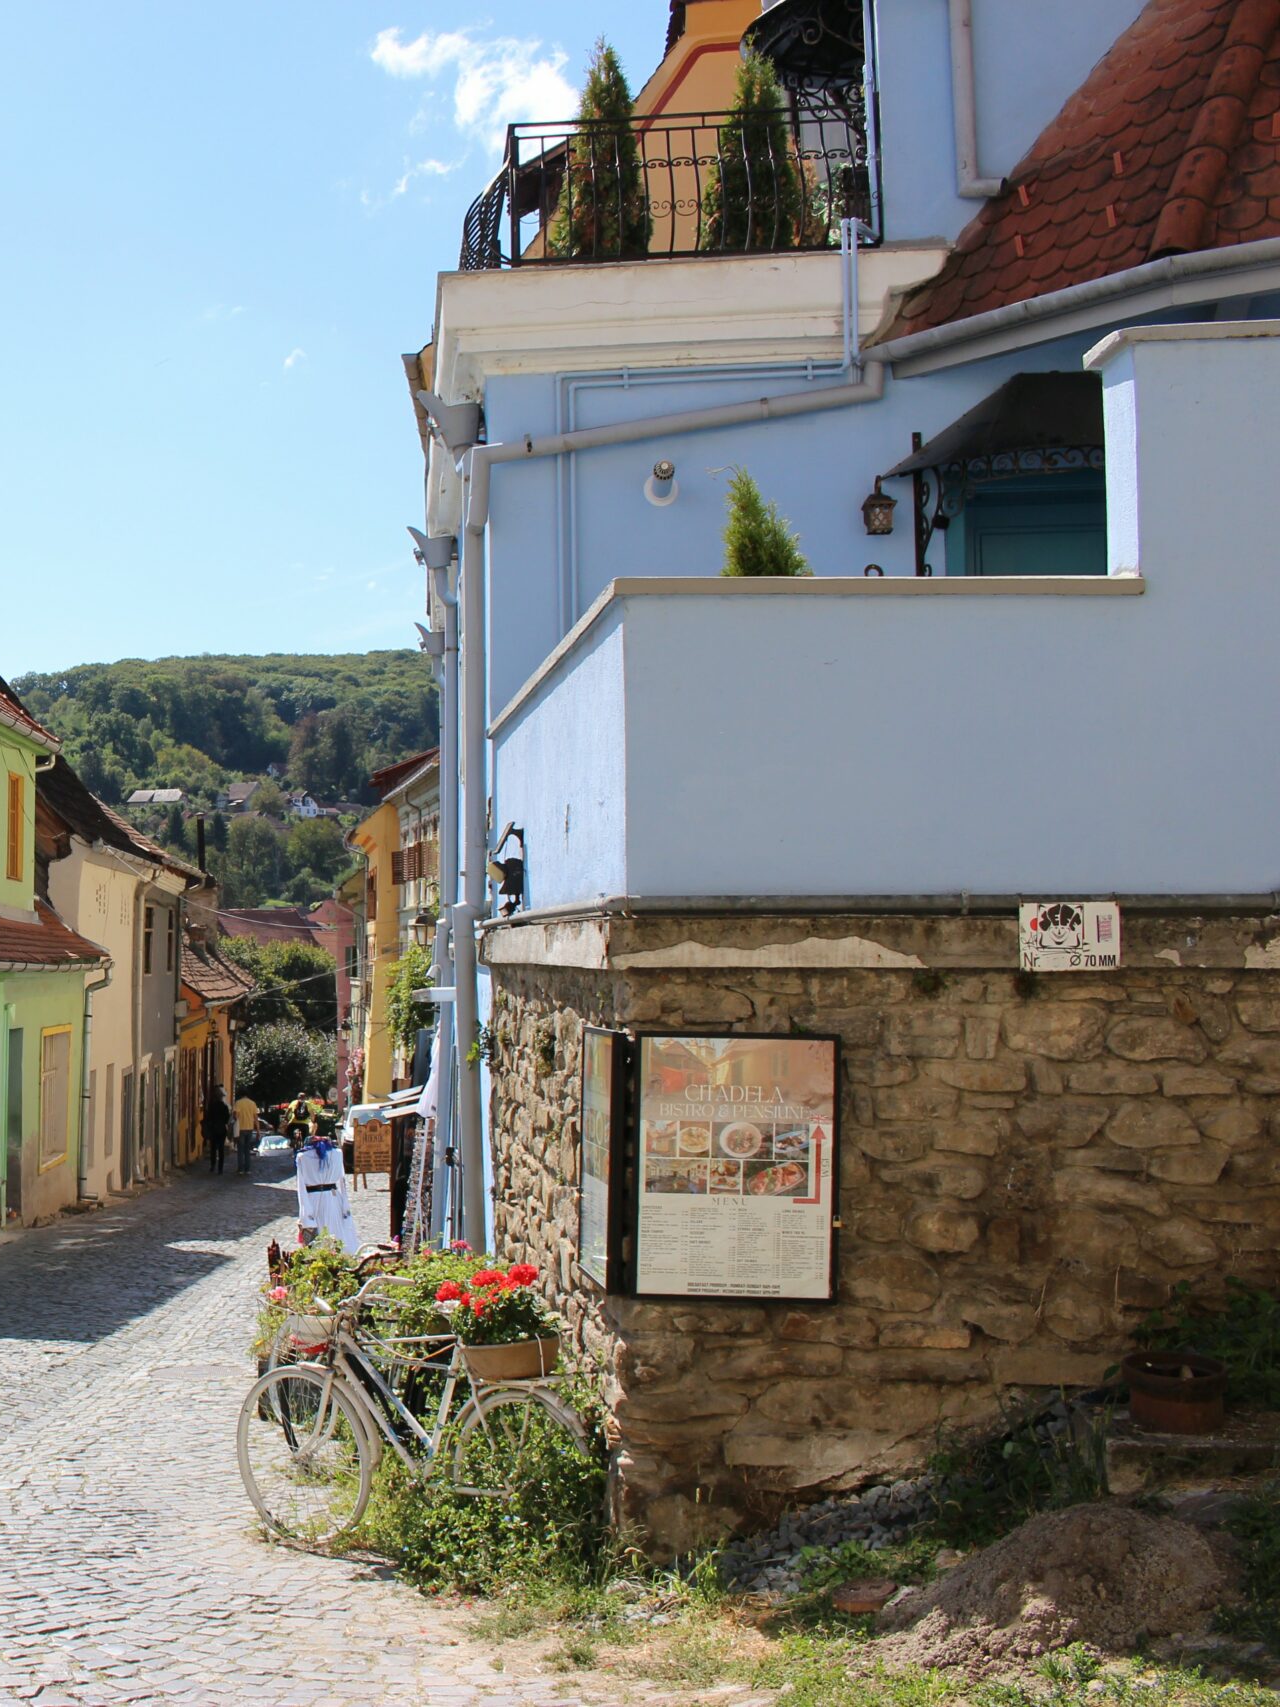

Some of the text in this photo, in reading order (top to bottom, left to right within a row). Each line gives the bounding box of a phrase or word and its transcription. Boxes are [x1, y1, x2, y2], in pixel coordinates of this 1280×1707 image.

[1023, 952, 1041, 967] Nr.
[1084, 954, 1097, 967] 70
[1098, 954, 1116, 967] MM
[685, 1084, 784, 1104] CITADELA
[659, 1103, 715, 1118] BISTRO
[717, 1104, 730, 1119] &
[711, 1196, 748, 1206] MENU
